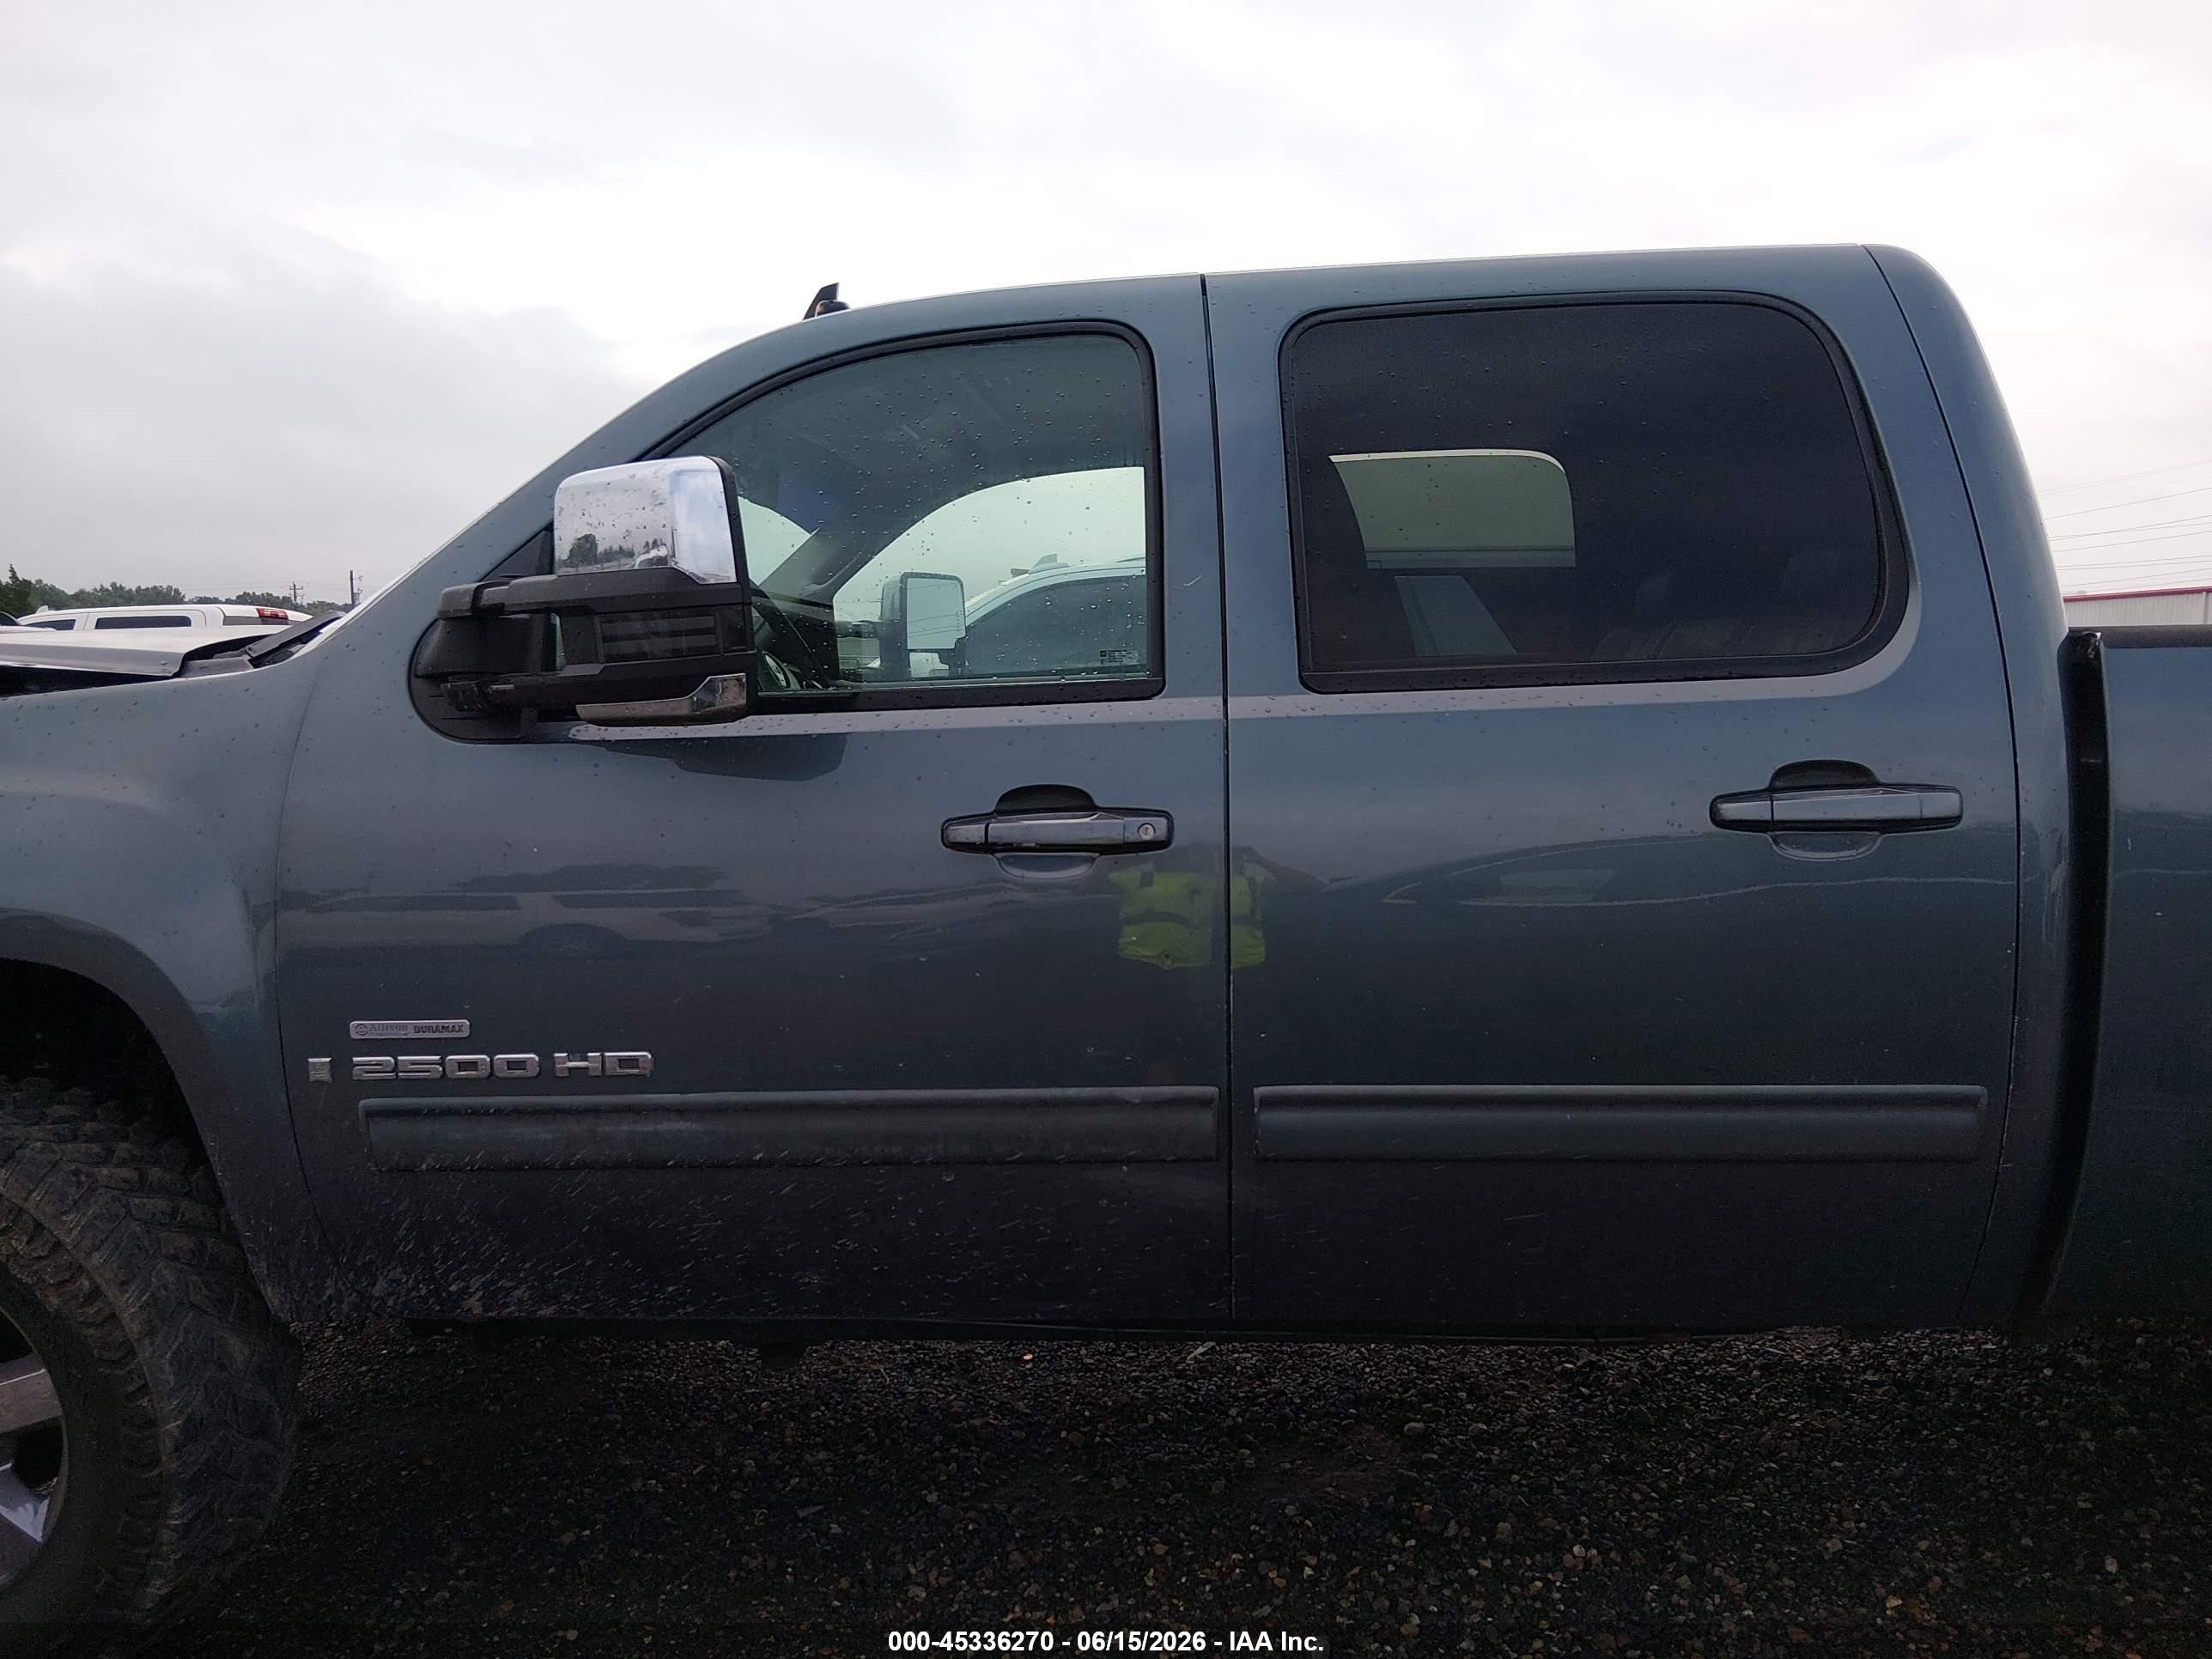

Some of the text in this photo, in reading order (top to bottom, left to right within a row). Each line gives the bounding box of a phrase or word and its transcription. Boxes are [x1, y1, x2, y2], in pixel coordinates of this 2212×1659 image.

[413, 1024, 465, 1034] DURAMAX
[352, 1054, 541, 1081] 2500
[553, 1051, 654, 1078] HD
